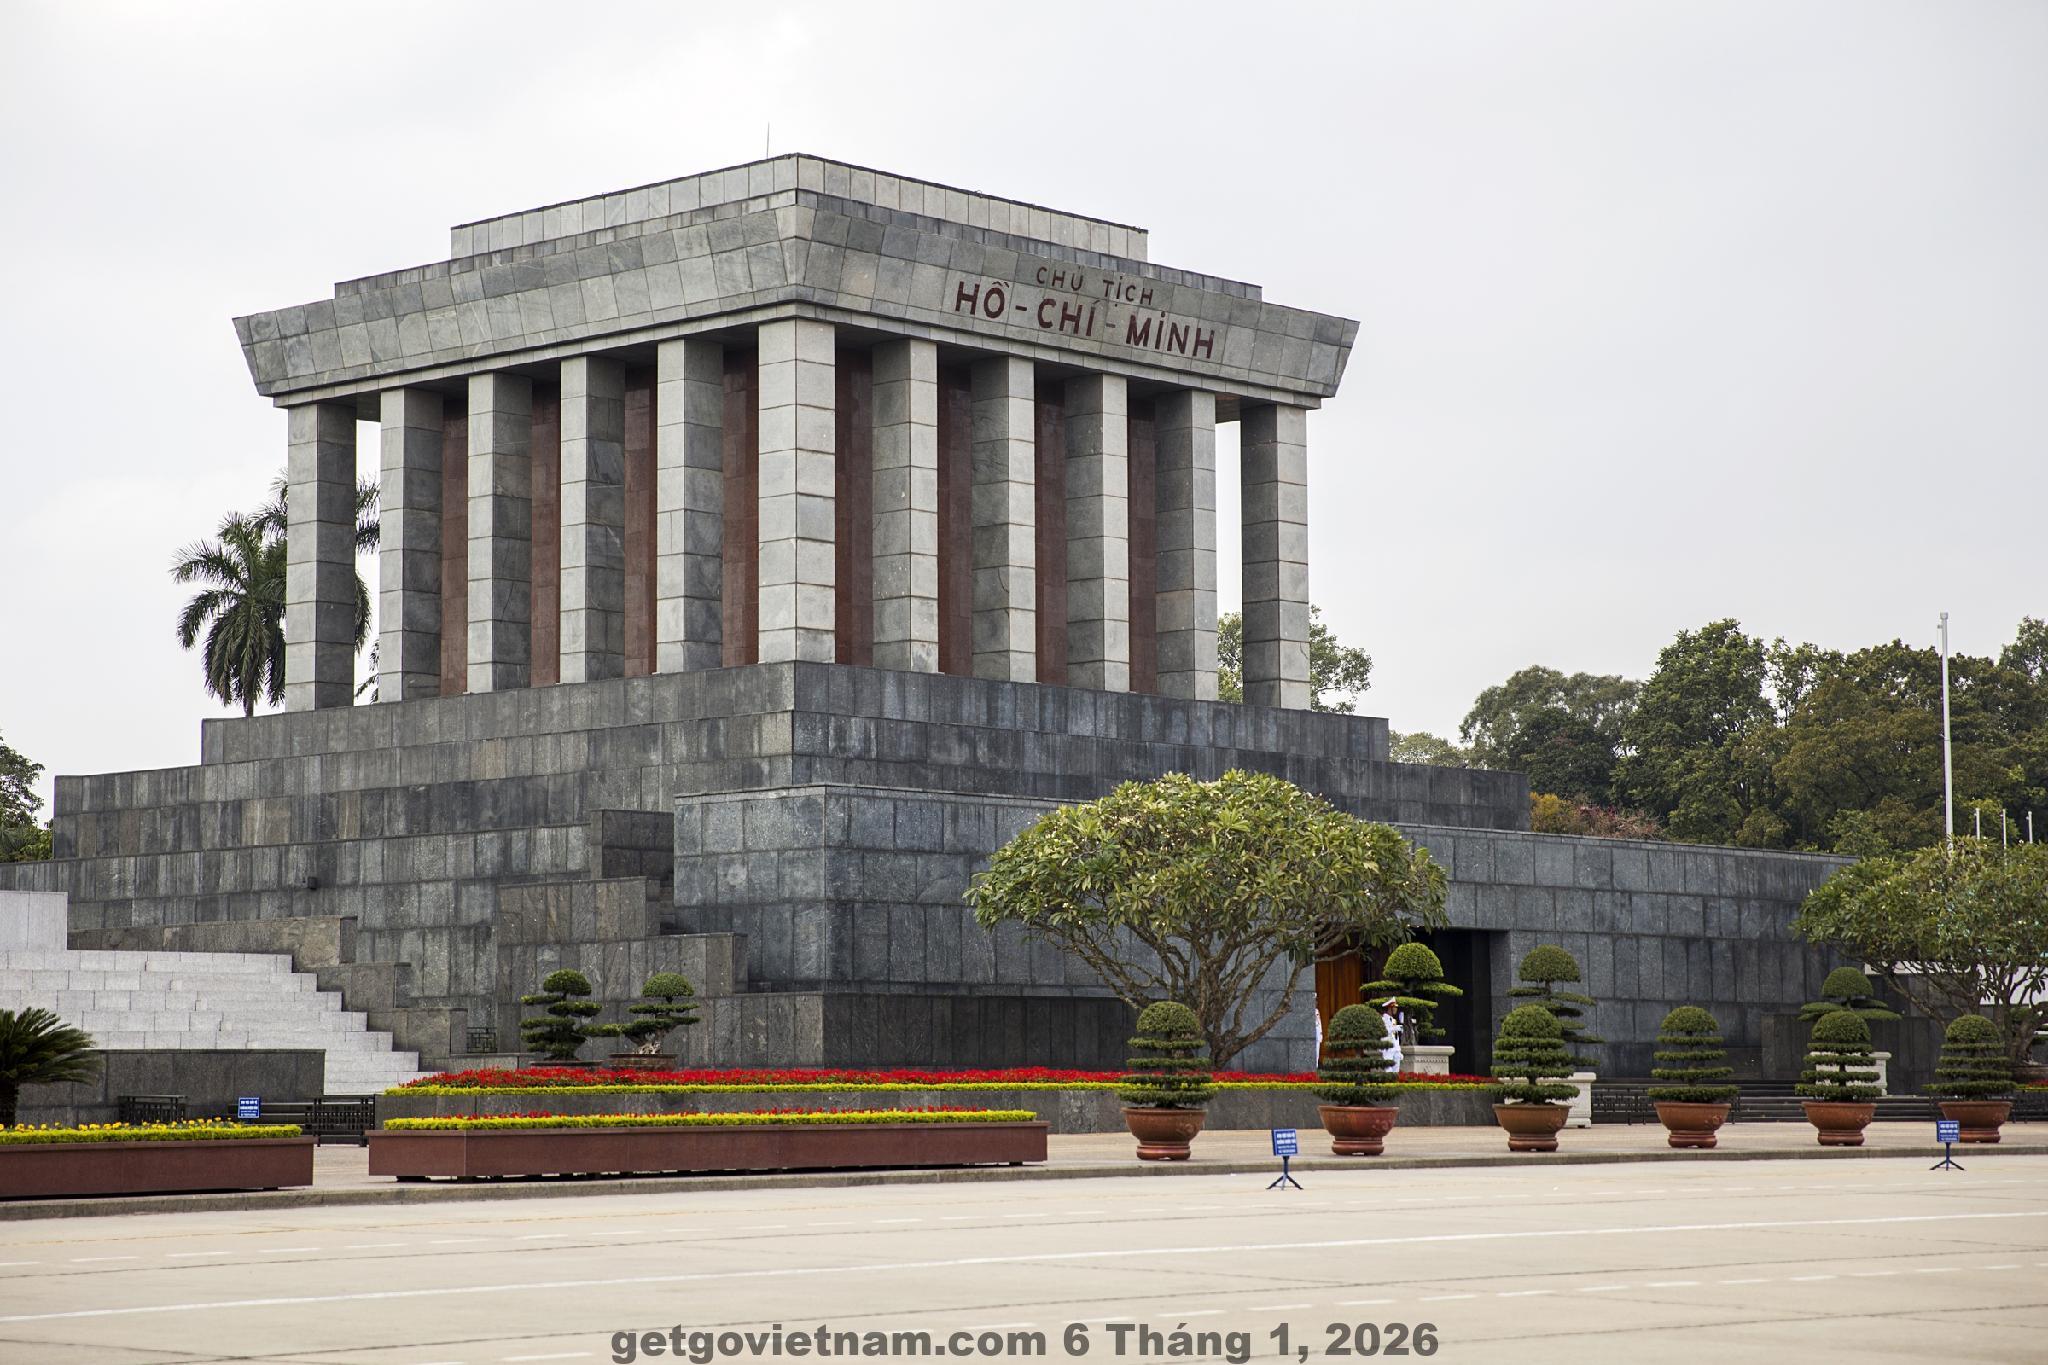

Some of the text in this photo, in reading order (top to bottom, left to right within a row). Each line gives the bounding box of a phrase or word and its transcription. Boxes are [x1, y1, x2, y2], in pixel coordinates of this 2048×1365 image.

[1036, 265, 1084, 292] CHỦ
[955, 281, 1010, 319] HỒ
[1037, 299, 1101, 337] CHÍ
[1125, 311, 1215, 359] MINH
